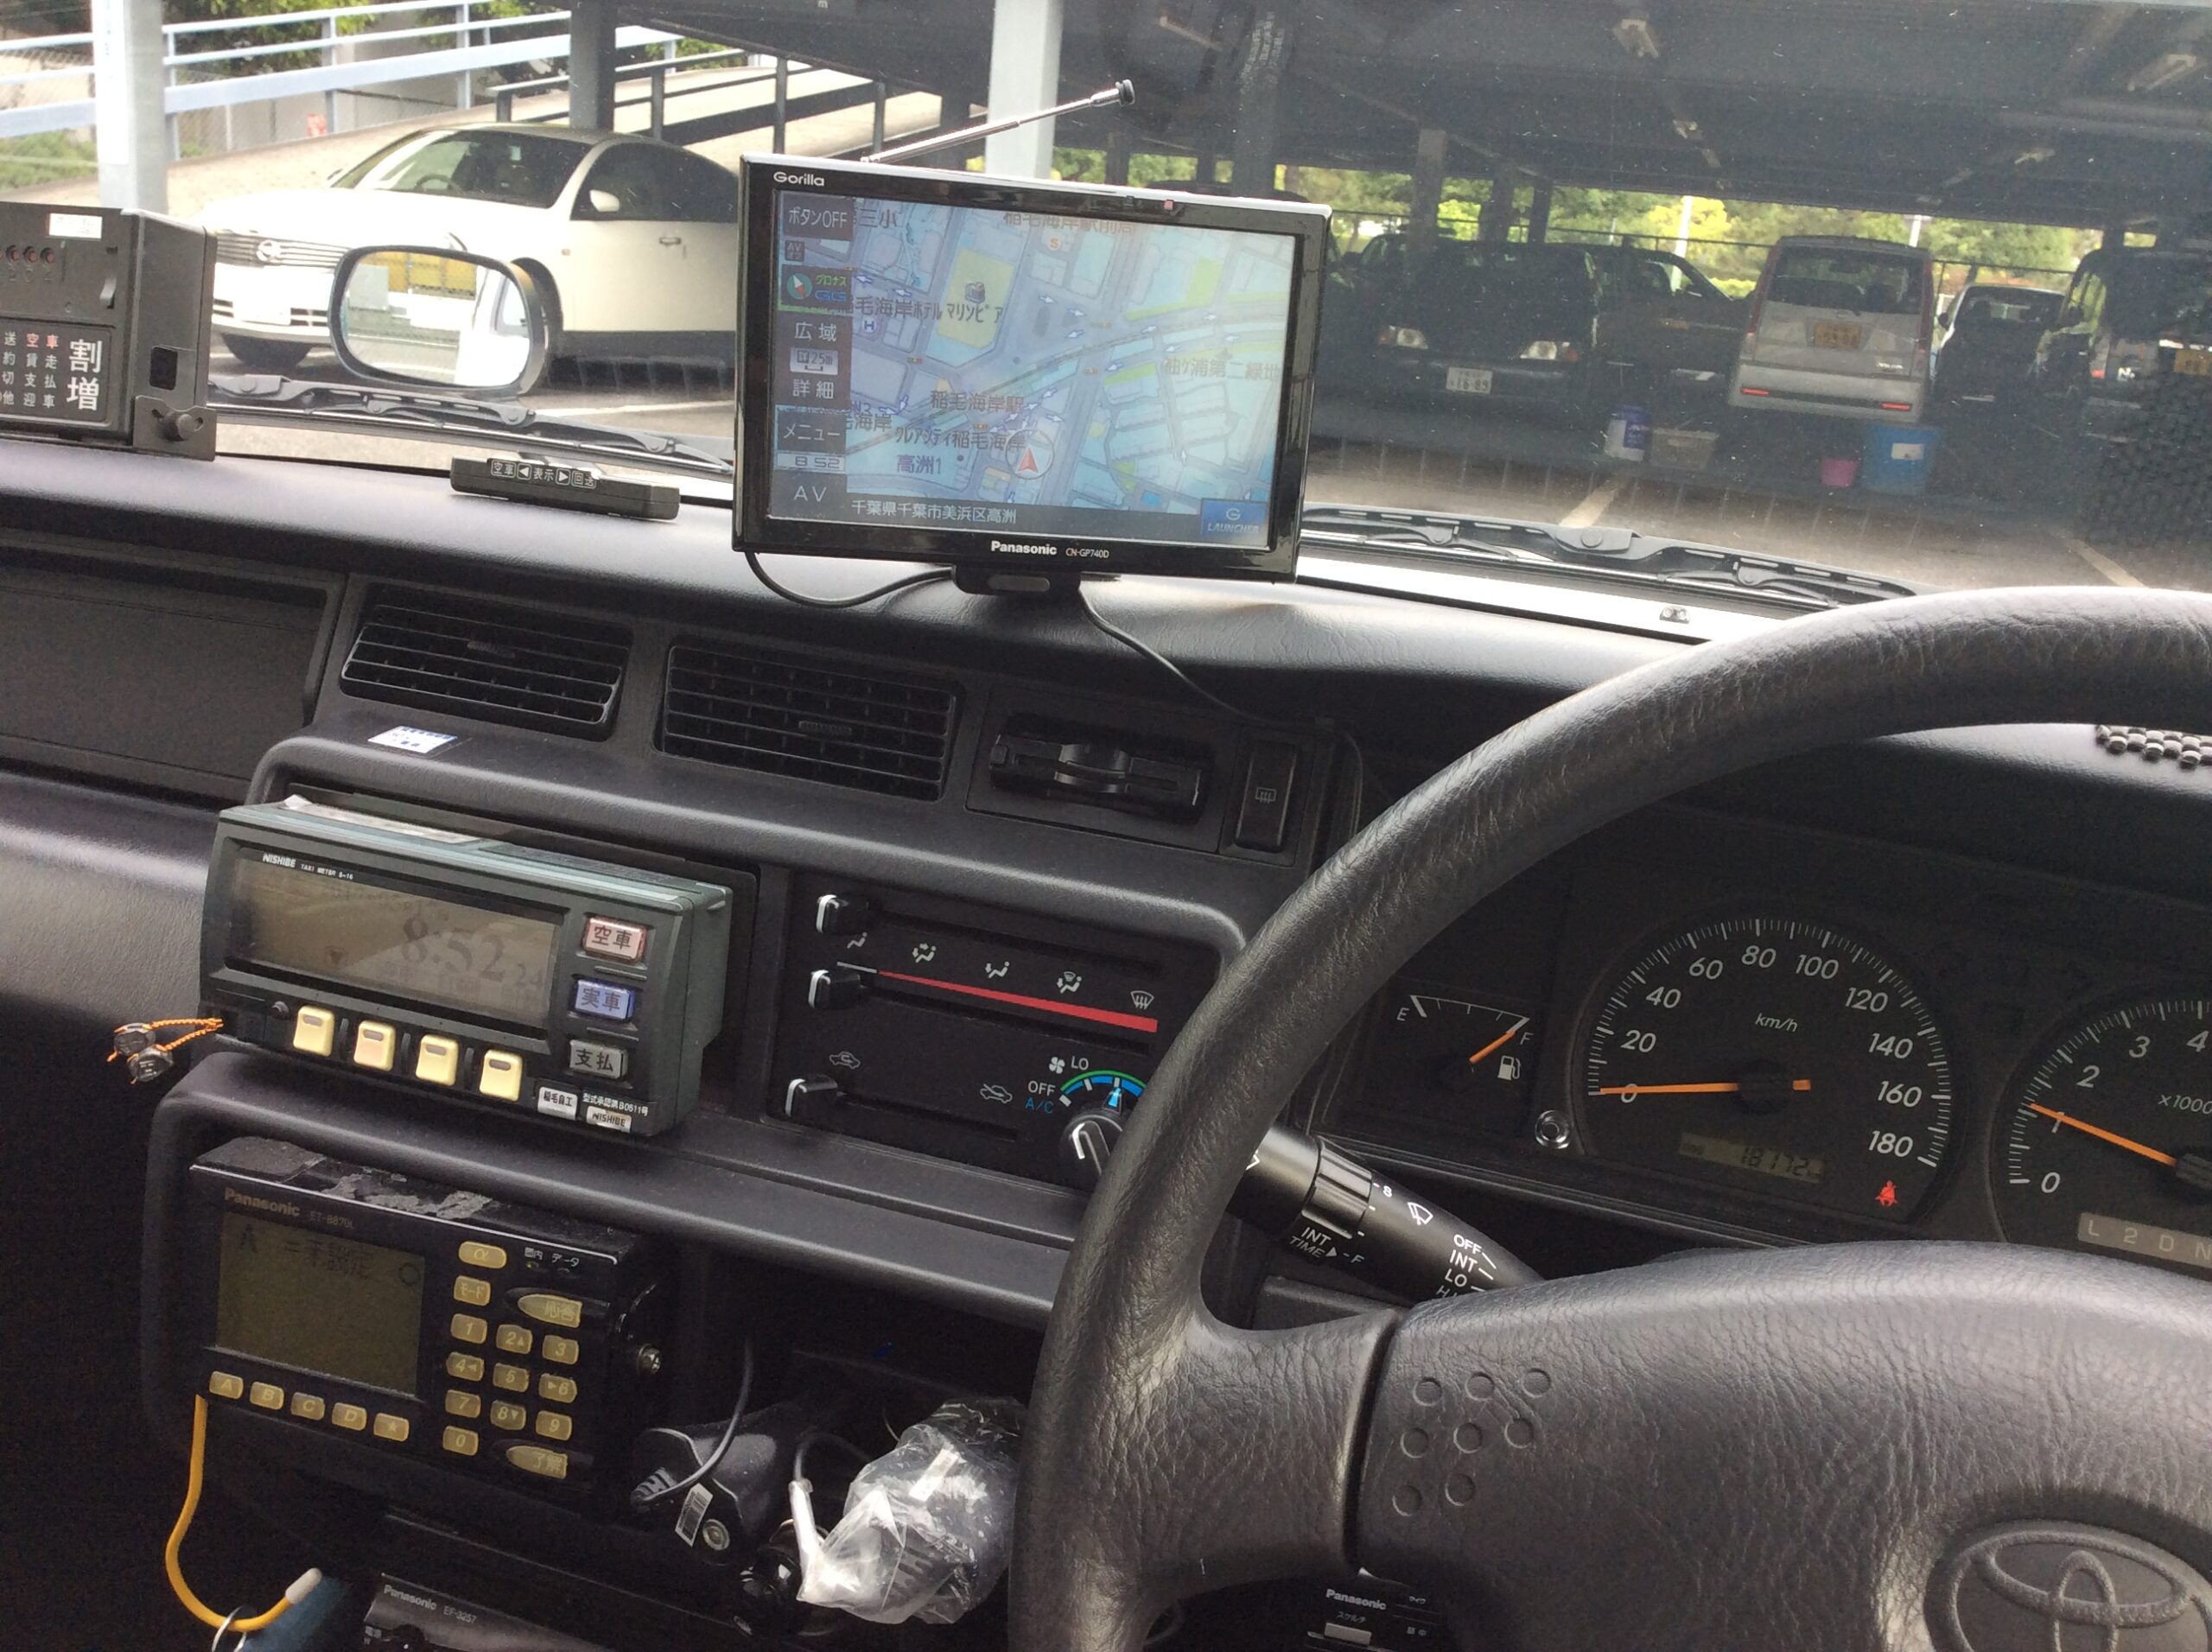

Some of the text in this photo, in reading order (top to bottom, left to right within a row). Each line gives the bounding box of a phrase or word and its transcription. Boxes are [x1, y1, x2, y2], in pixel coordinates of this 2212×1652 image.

[773, 171, 825, 187] Gorilla
[788, 206, 848, 228] ボタンOFF
[795, 322, 837, 342] 広域
[66, 338, 104, 412] 割増
[792, 378, 835, 400] 詳細
[783, 423, 841, 442] メニュー
[493, 461, 514, 476] 空車
[533, 467, 554, 481] 表示
[851, 499, 1017, 524] 千葉県千葉市美浜区高洲
[991, 540, 1109, 559] Panasonic CN-GP740D
[263, 852, 296, 868] NISHIBE
[591, 925, 632, 950] 空車
[1740, 944, 1777, 969] 80
[1688, 956, 1724, 981] 60
[1796, 953, 1840, 981] 100
[580, 988, 621, 1013] 実車
[1645, 986, 1681, 1009] 40
[1845, 987, 1889, 1013] 120
[1396, 1007, 1410, 1022] E
[1755, 1012, 1799, 1033] km/h
[1519, 1032, 1535, 1045] F
[1620, 1028, 1657, 1054] 20
[1868, 1032, 1914, 1060] 140
[2128, 1035, 2152, 1058] 3
[2186, 1030, 2209, 1053] 4
[575, 1048, 614, 1072] 支払
[1070, 1055, 1090, 1071] LO
[2075, 1064, 2101, 1089] 2
[1027, 1080, 1056, 1096] OFF
[1877, 1080, 1923, 1109] 160
[1025, 1097, 1054, 1115] A/C
[592, 1112, 626, 1128] NISHIBE
[1868, 1129, 1914, 1158] 180
[2040, 1171, 2061, 1194] 0
[224, 1187, 301, 1217] Panasonic
[1301, 1226, 1332, 1246] INT
[1453, 1234, 1482, 1255] OFF
[2088, 1219, 2100, 1236] L
[2124, 1227, 2138, 1244] 2
[2158, 1234, 2175, 1253] D
[1290, 1236, 1326, 1258] TIME
[1351, 1254, 1365, 1265] F
[1449, 1249, 1478, 1273] INT
[1444, 1268, 1468, 1287] LO
[466, 1322, 473, 1335] 1
[505, 1331, 516, 1346] 2
[556, 1343, 566, 1357] 3
[455, 1359, 466, 1372] 4
[220, 1378, 235, 1390] A
[505, 1369, 516, 1383] 5
[262, 1388, 275, 1401] B
[558, 1382, 569, 1395] 6
[302, 1399, 316, 1412] C
[459, 1397, 470, 1410] 7
[498, 1407, 508, 1420] 8
[344, 1410, 359, 1422] D
[549, 1418, 560, 1433] 9
[455, 1433, 467, 1447] 0
[384, 1584, 437, 1611] Panasonic
[1325, 1588, 1387, 1611] Panasonic
